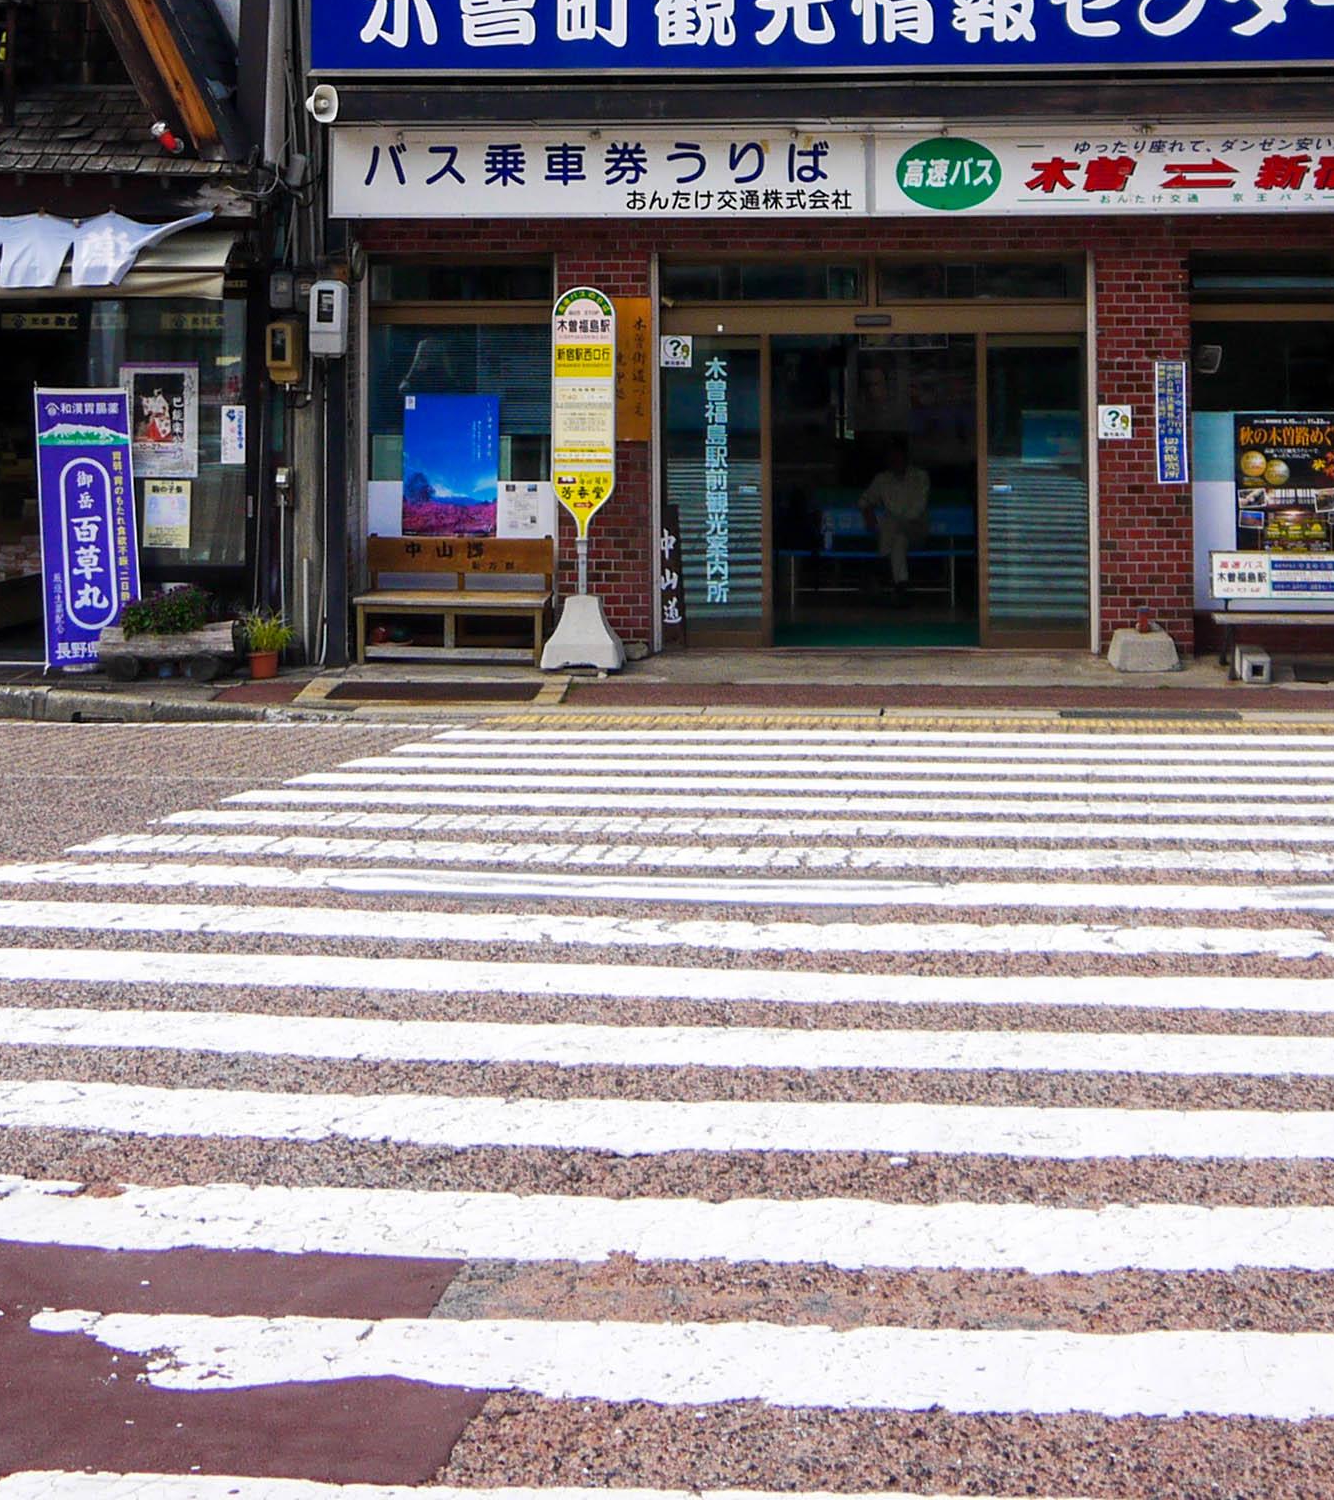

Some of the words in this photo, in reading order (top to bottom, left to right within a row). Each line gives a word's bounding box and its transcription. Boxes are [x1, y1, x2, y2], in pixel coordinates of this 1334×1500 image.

[364, 140, 830, 187] バス乗車券うりば
[902, 155, 995, 190] 高速バス
[1024, 156, 1138, 193] 木曽
[625, 188, 854, 211] おんたけ交通株式会社
[1099, 192, 1200, 204] おんたけ交通
[1232, 192, 1317, 203] 京王バス
[557, 319, 610, 332] 木曽福島駅
[557, 347, 610, 361] 新宿駅西口行
[60, 402, 120, 415] 和漢胃腸薬
[704, 356, 729, 604] 木曽福島駅前観光案内所
[69, 470, 109, 610] 御岳百草丸
[659, 527, 683, 626] 中山道
